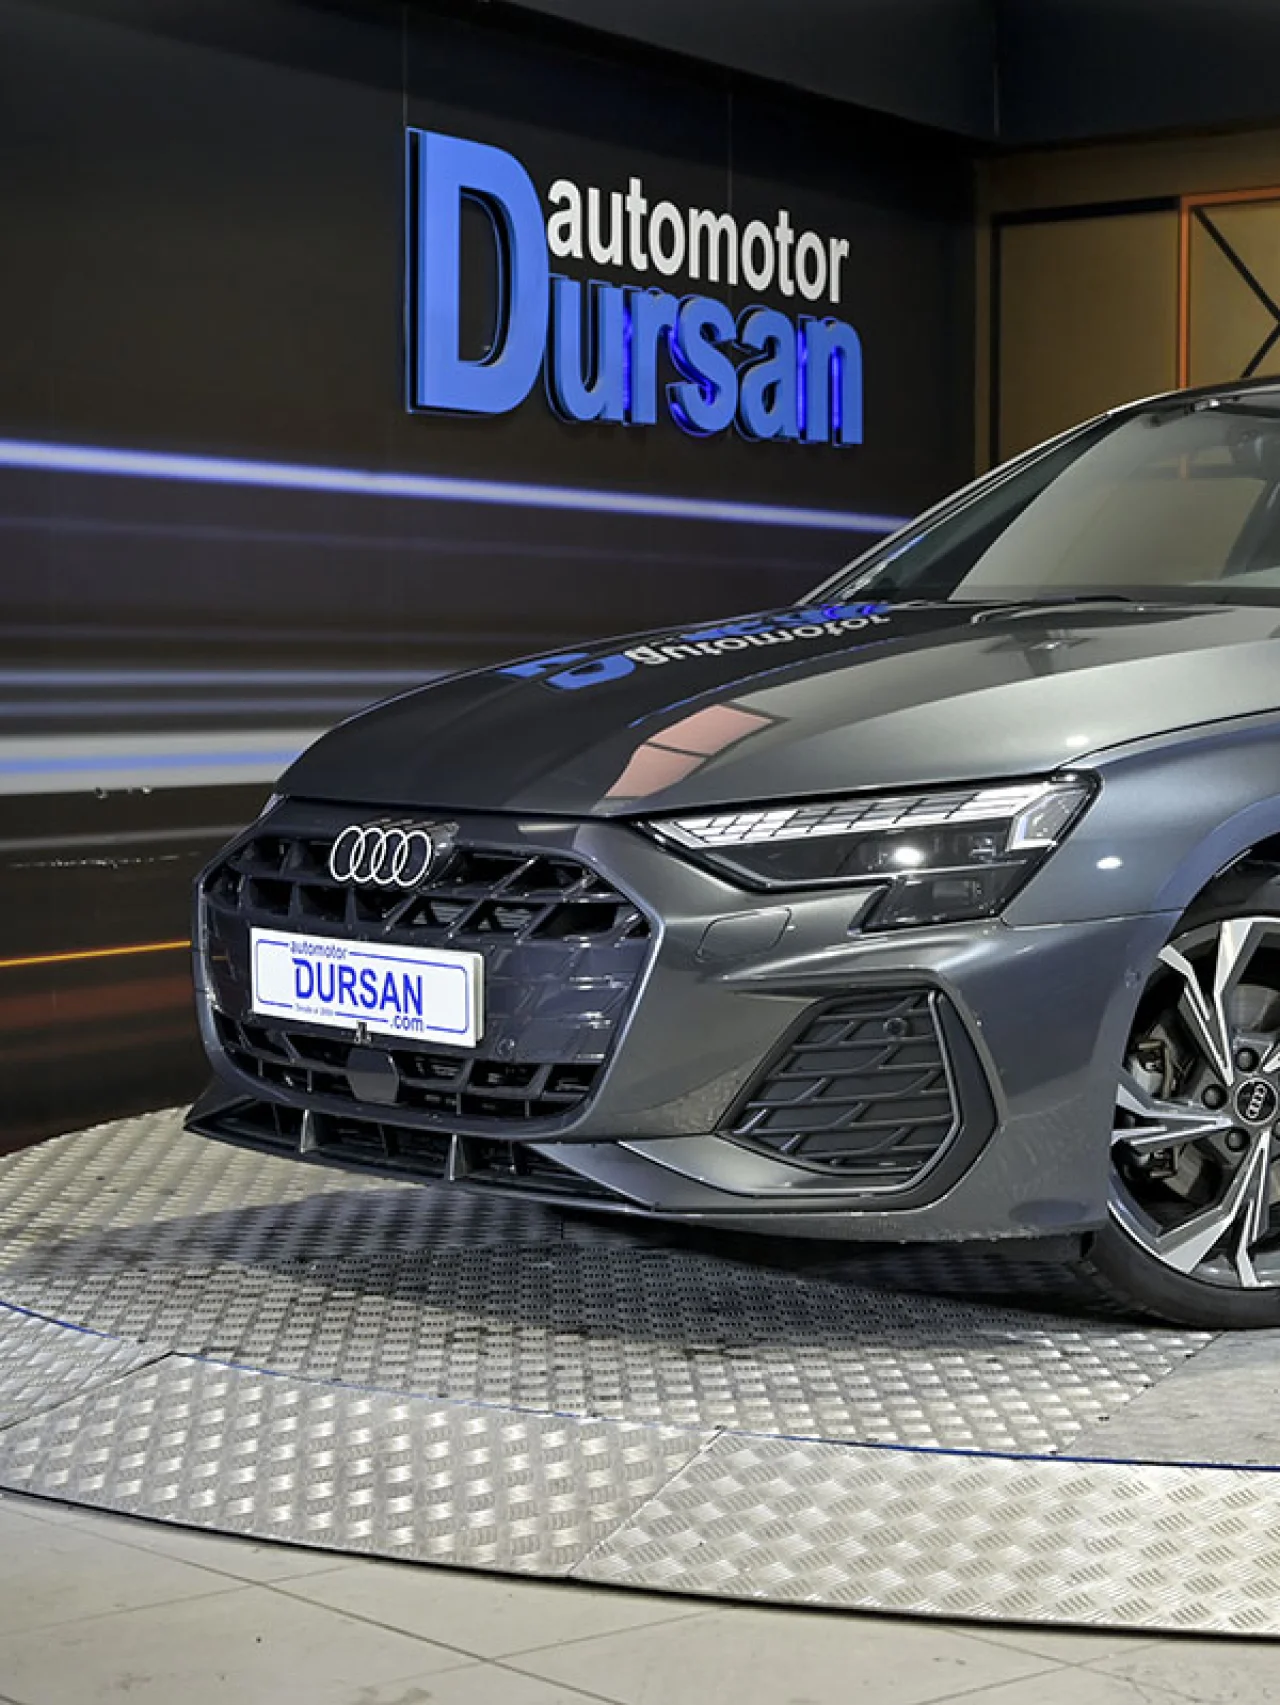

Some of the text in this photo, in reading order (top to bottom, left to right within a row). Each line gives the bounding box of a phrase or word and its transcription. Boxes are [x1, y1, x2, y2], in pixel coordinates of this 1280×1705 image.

[547, 177, 850, 303] automotor
[406, 126, 863, 447] Dursan
[290, 941, 348, 960] automotor
[292, 957, 423, 1016] DURSAN
[390, 1015, 424, 1032] .com
